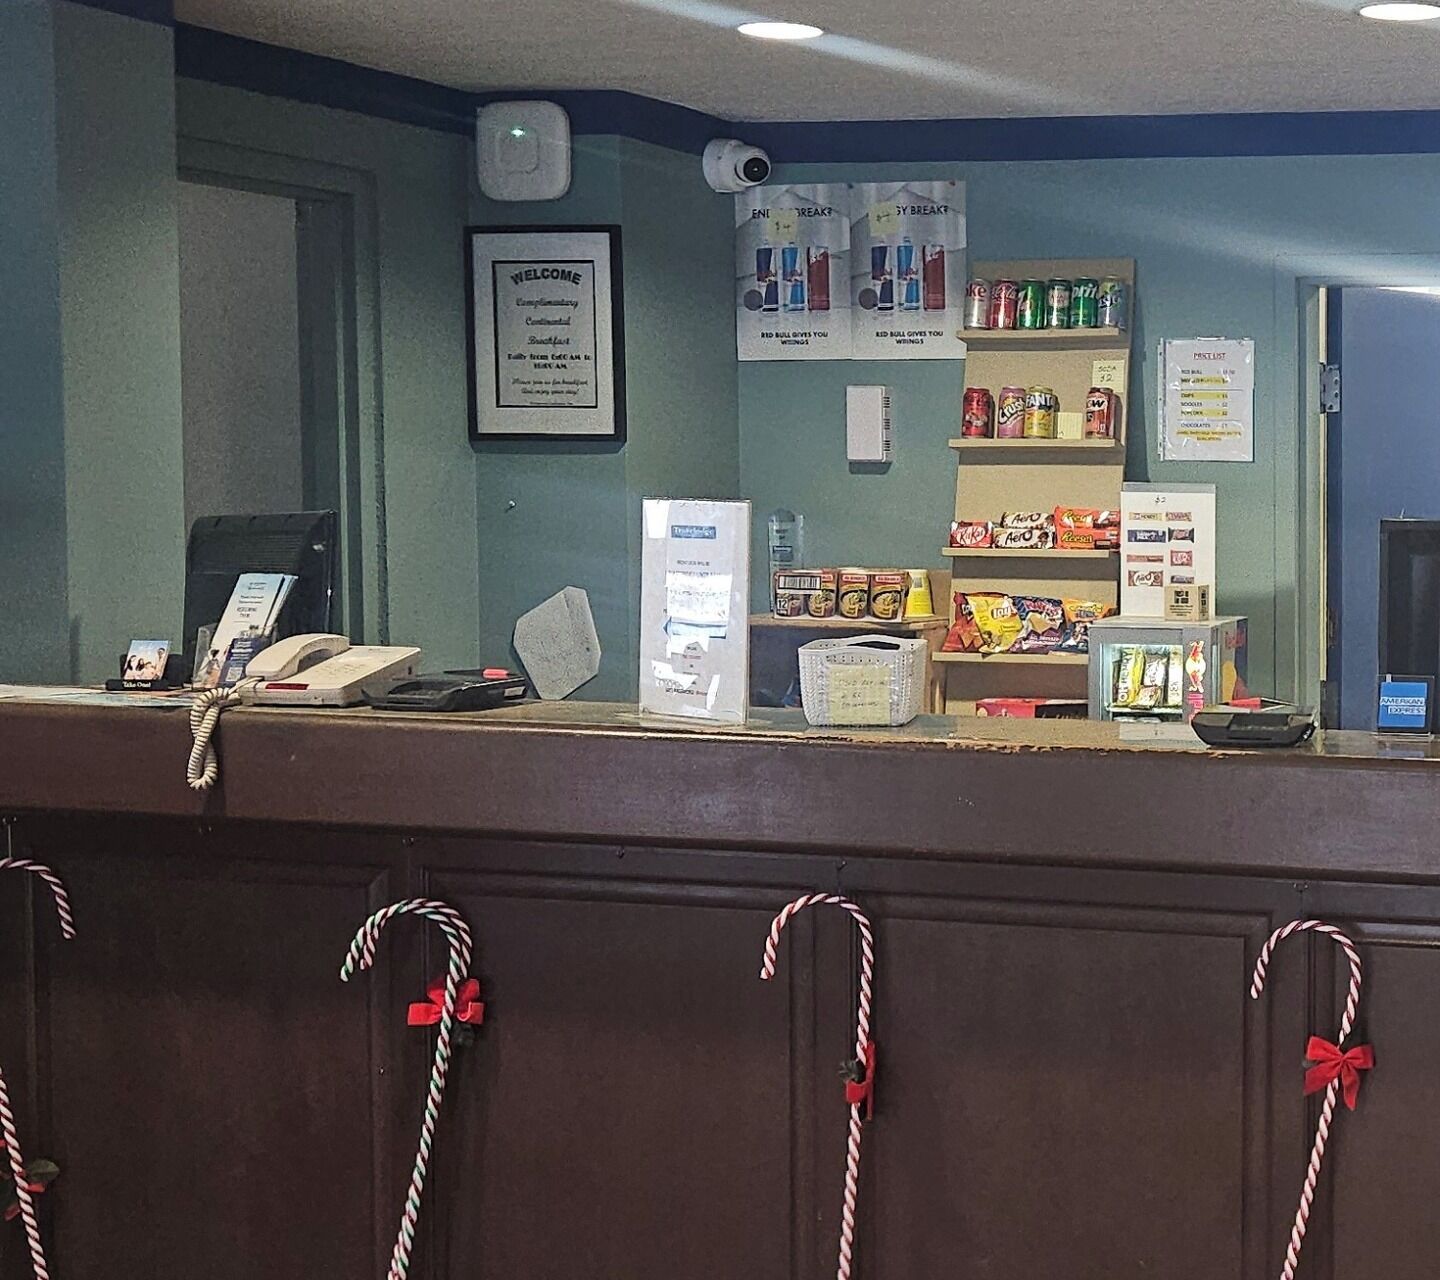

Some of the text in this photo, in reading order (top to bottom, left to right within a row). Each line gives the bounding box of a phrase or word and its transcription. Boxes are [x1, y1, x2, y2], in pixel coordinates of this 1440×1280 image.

[910, 205, 949, 216] BREAK?
[510, 267, 583, 286] WELCOME
[1004, 529, 1034, 543] Aero
[776, 598, 788, 610] 12
[122, 681, 137, 689] Take
[1380, 696, 1425, 706] AMERICAN
[1388, 705, 1426, 715] EXPRESS
